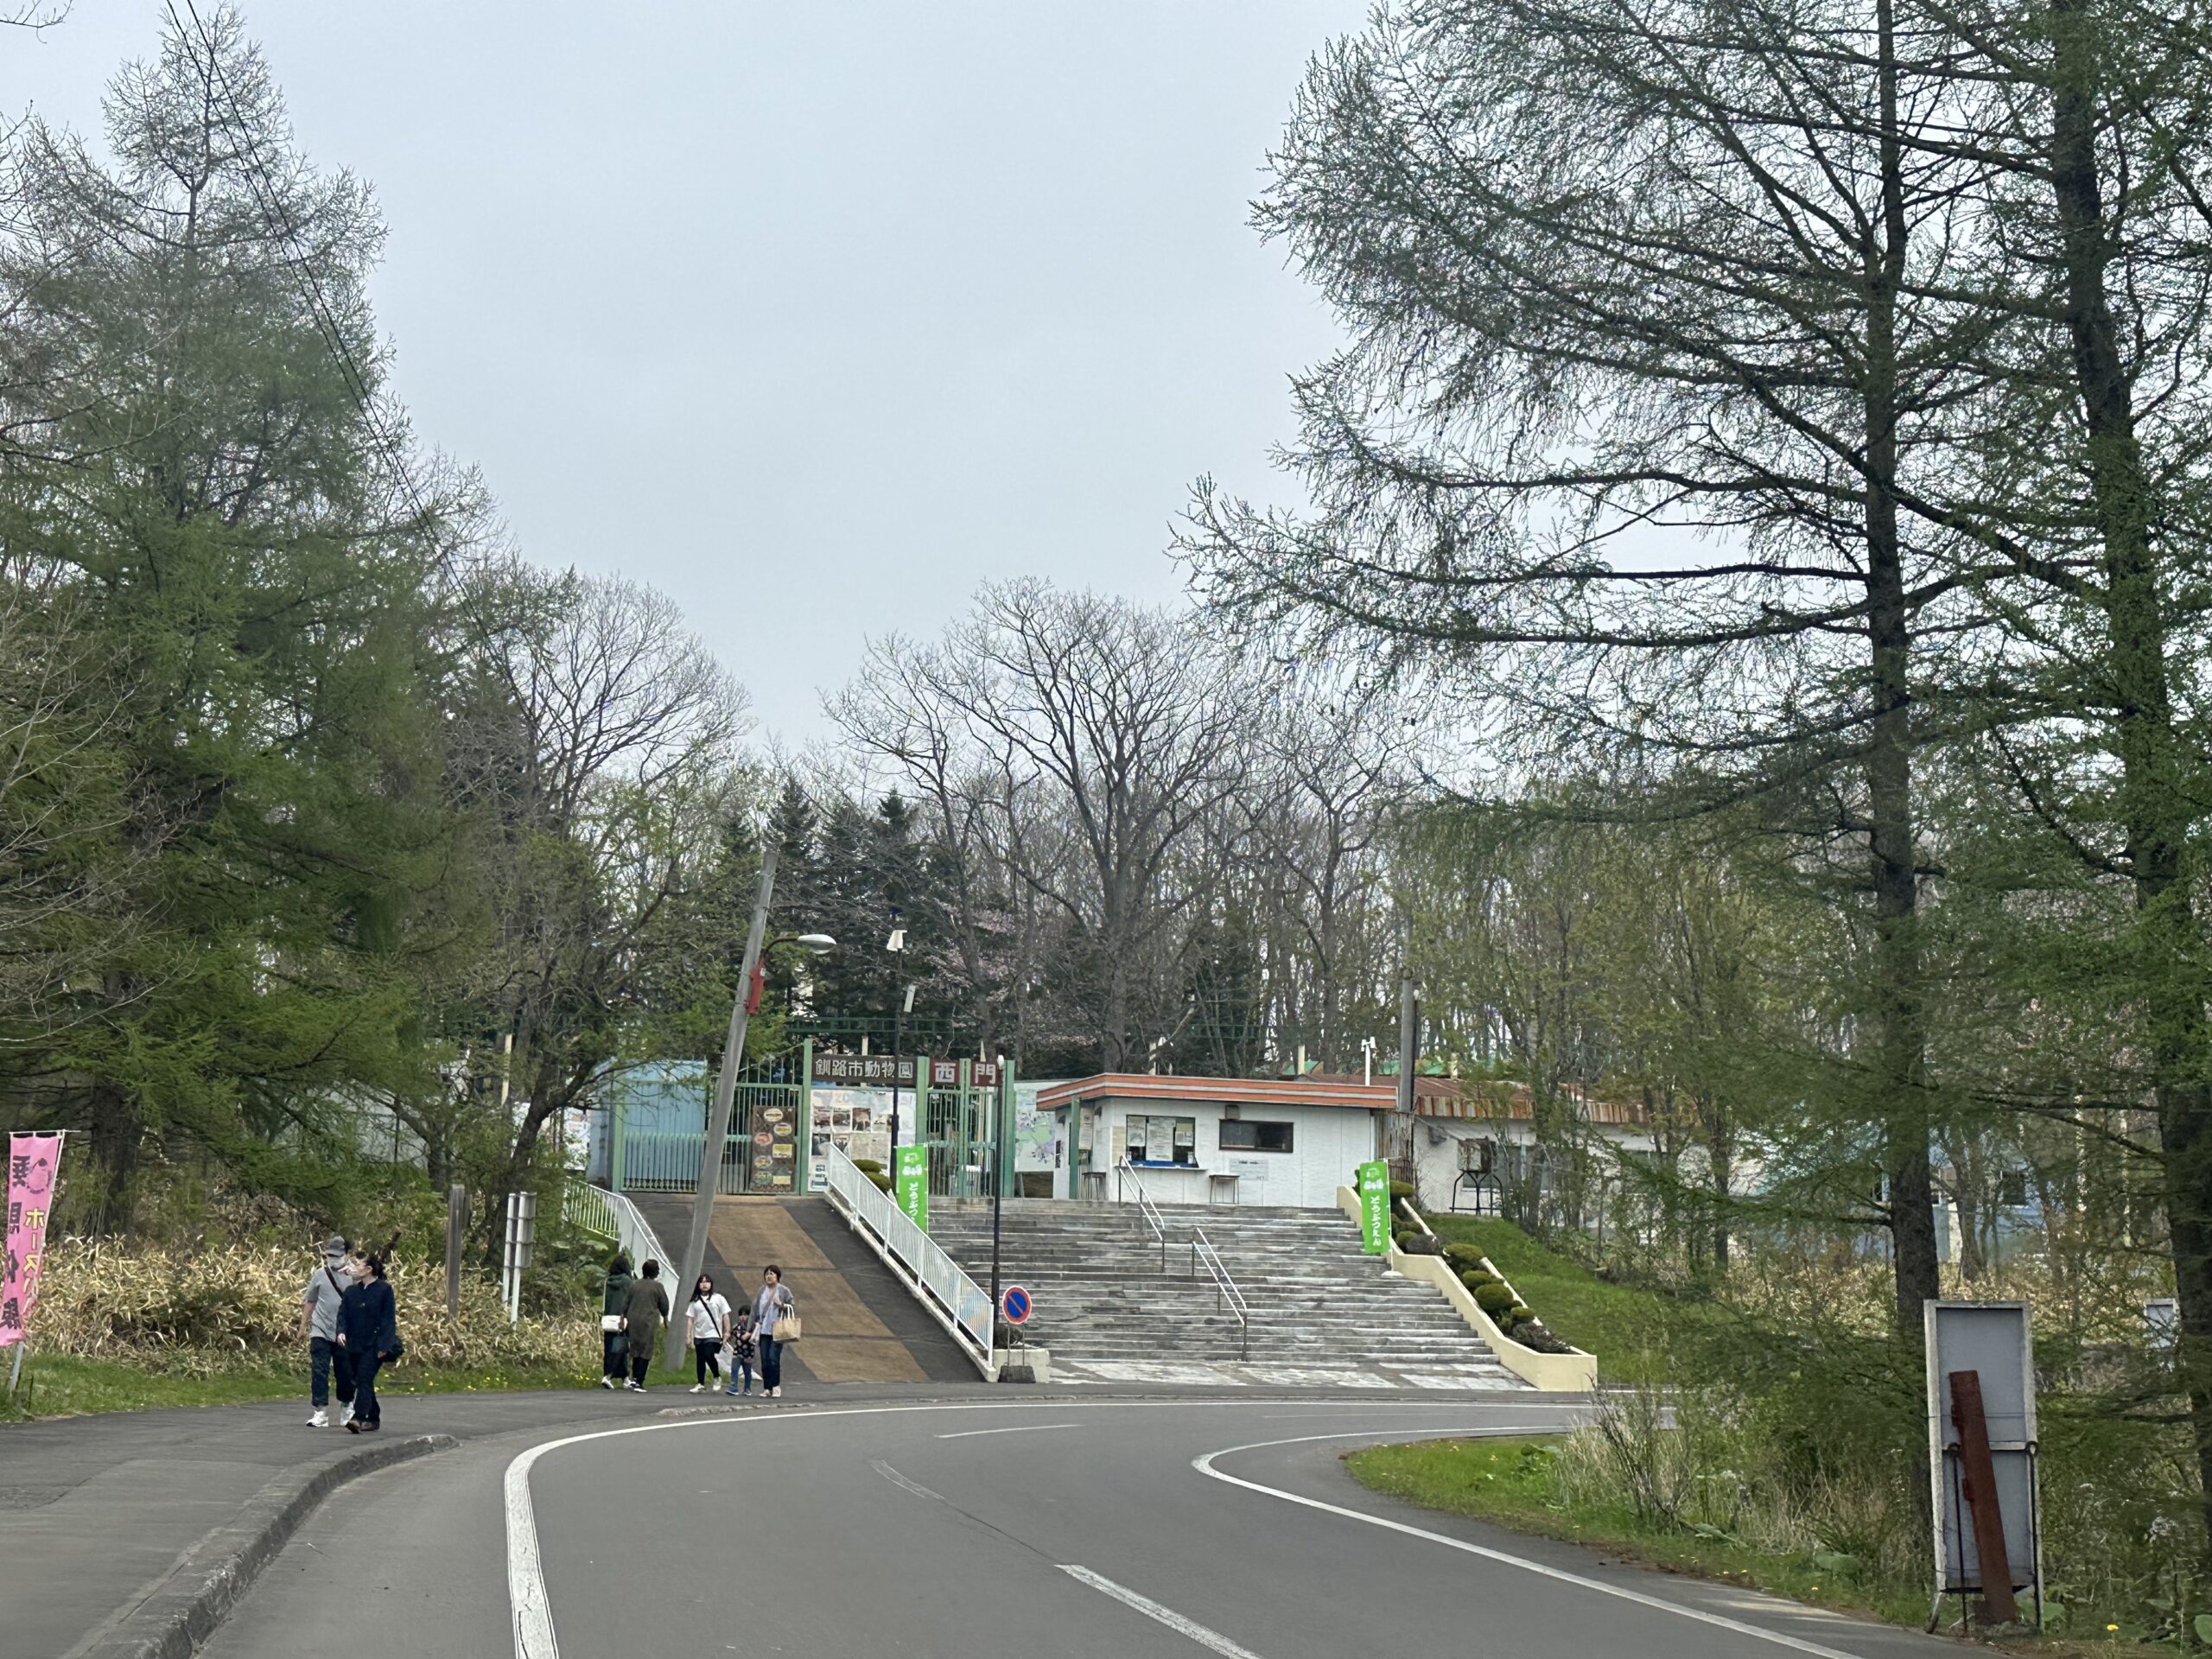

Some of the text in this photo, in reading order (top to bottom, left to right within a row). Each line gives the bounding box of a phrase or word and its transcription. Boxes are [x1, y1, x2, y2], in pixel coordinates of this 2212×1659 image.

[815, 1058, 913, 1078] 釧路市動物園
[909, 1181, 918, 1221] どうぶつ
